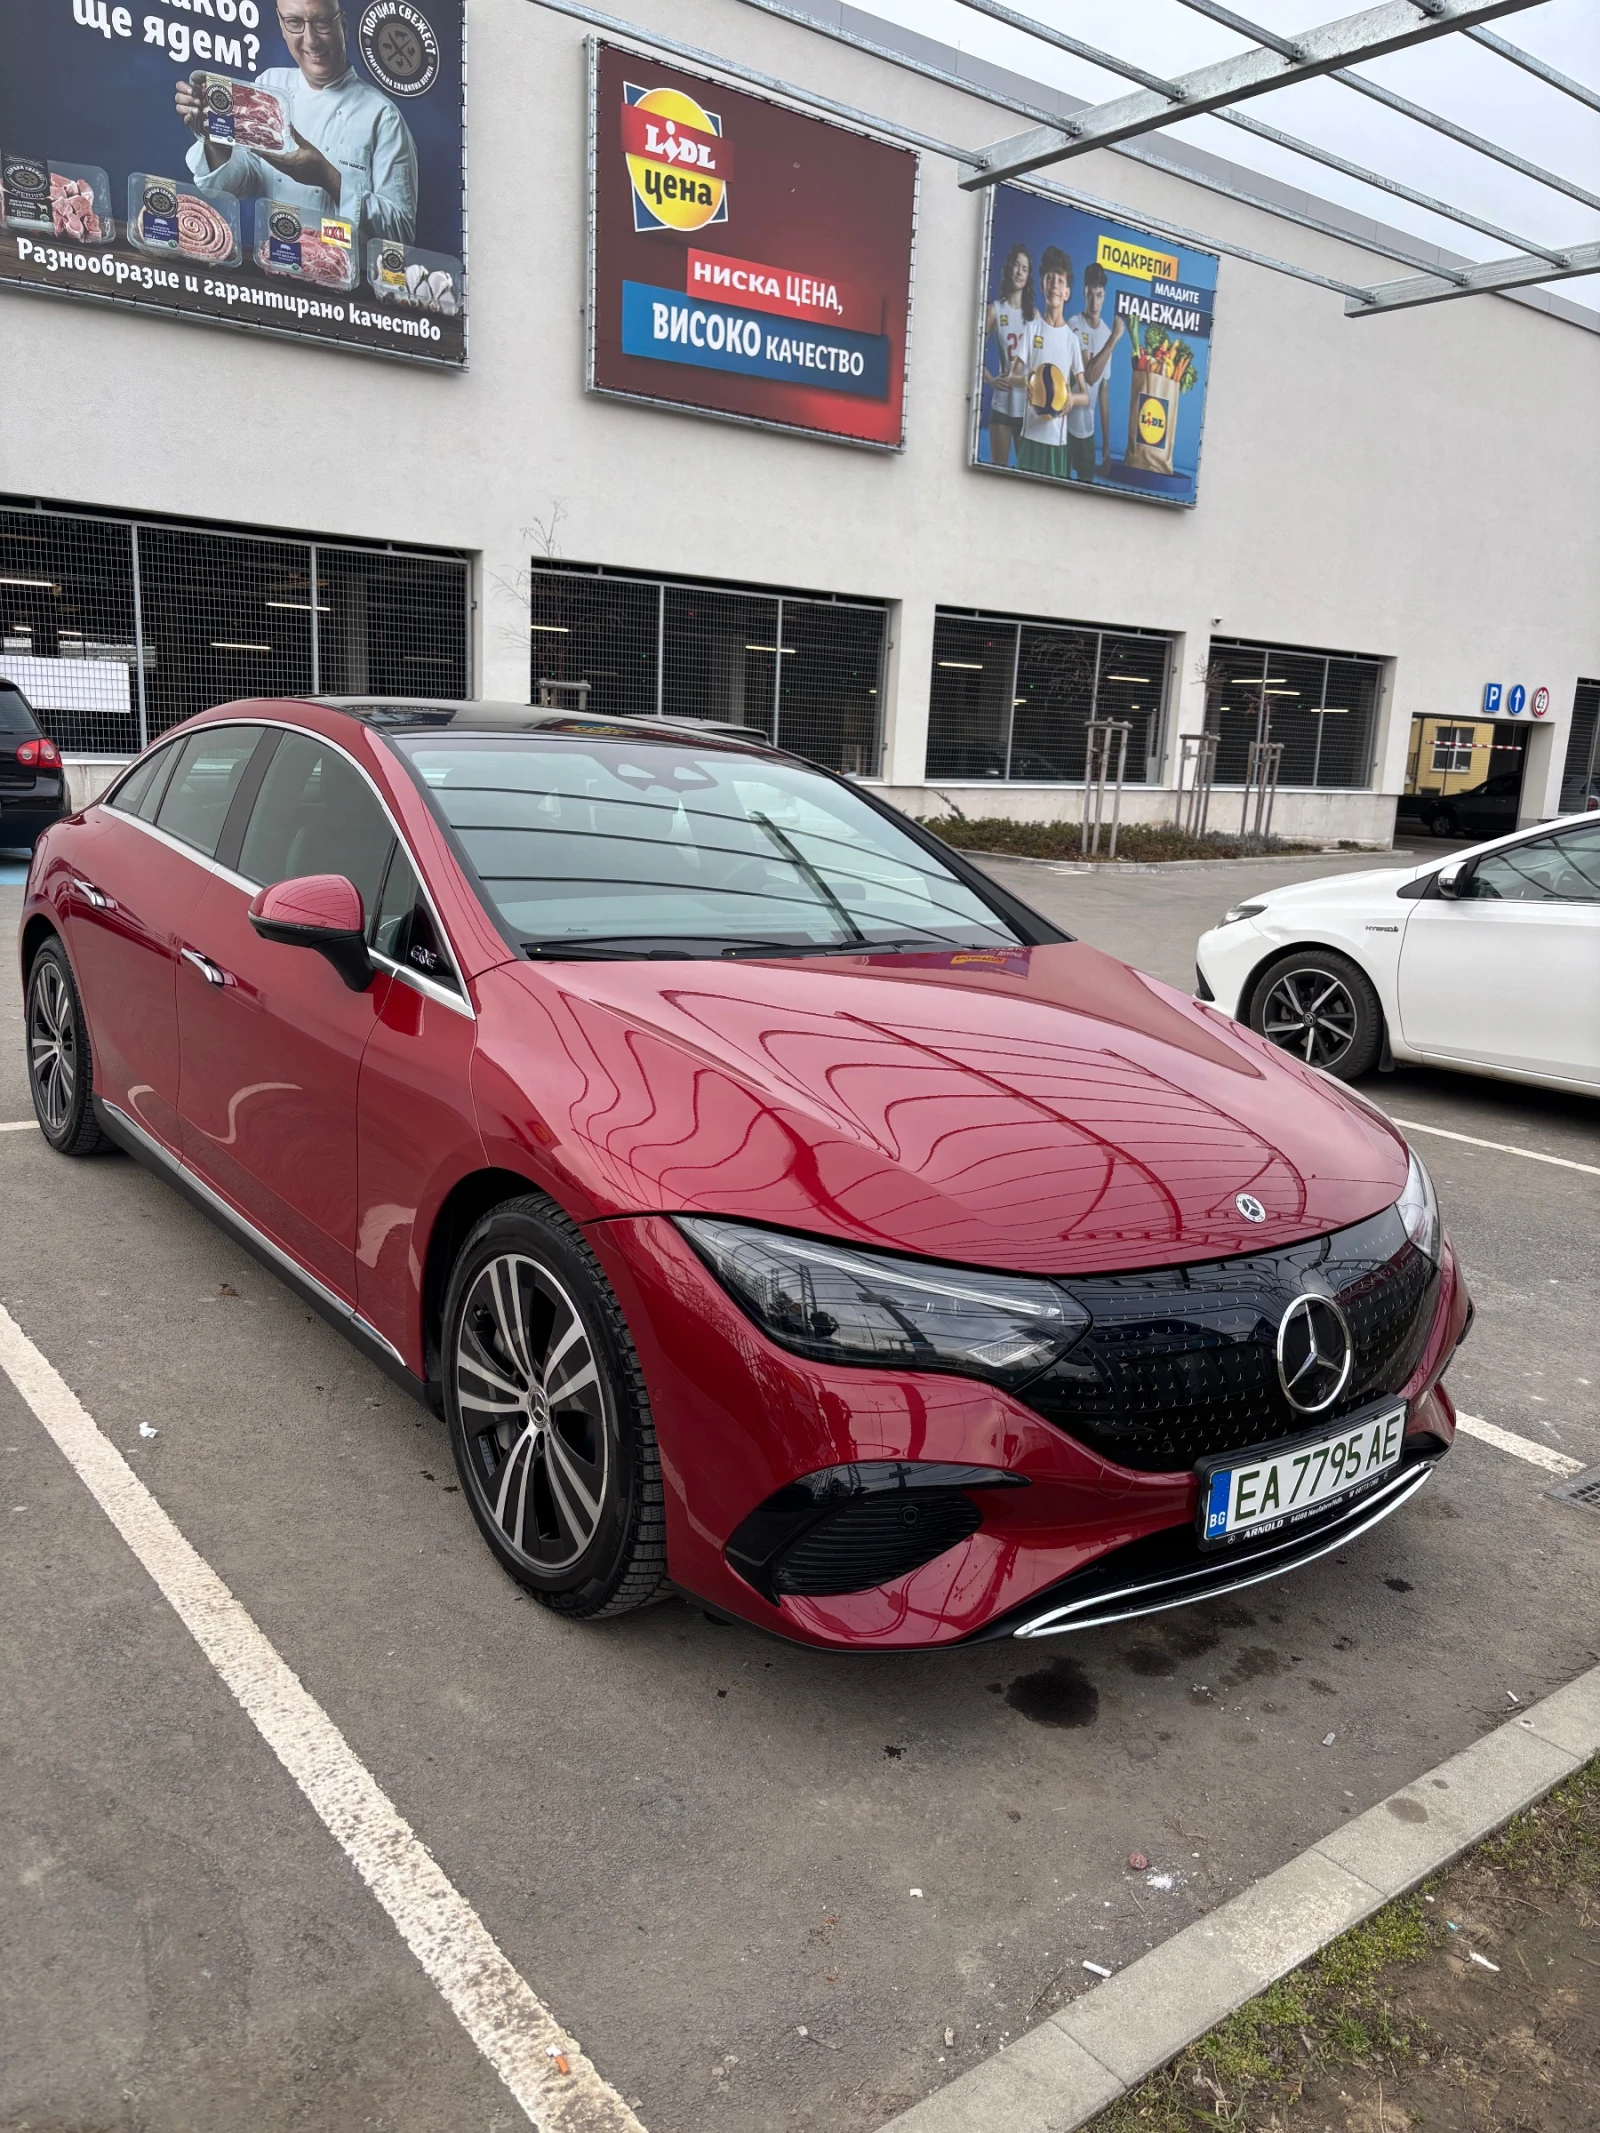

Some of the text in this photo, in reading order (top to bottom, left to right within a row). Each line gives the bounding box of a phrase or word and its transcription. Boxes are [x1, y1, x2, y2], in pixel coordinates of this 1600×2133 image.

[72, 0, 260, 72] ще ядем?
[362, 2, 436, 55] ПОРЦИЯ СВЕЖЕСТ
[645, 169, 713, 206] цена
[1102, 244, 1172, 278] ПОДКРЕПИ
[16, 237, 441, 341] Разнообразие и гарантирано качество
[694, 261, 844, 315] НИСКА ЦЕНА,
[1155, 282, 1200, 305] МЛАДИТЕ
[1118, 293, 1200, 332] НАДЕЖДИ!
[652, 302, 865, 376] ВИСОКО КАЧЕСТВО
[1488, 686, 1499, 708] P
[1234, 1414, 1401, 1522] EA 7795 AE
[1209, 1511, 1226, 1528] BG
[1243, 1519, 1284, 1539] ARNOLD
